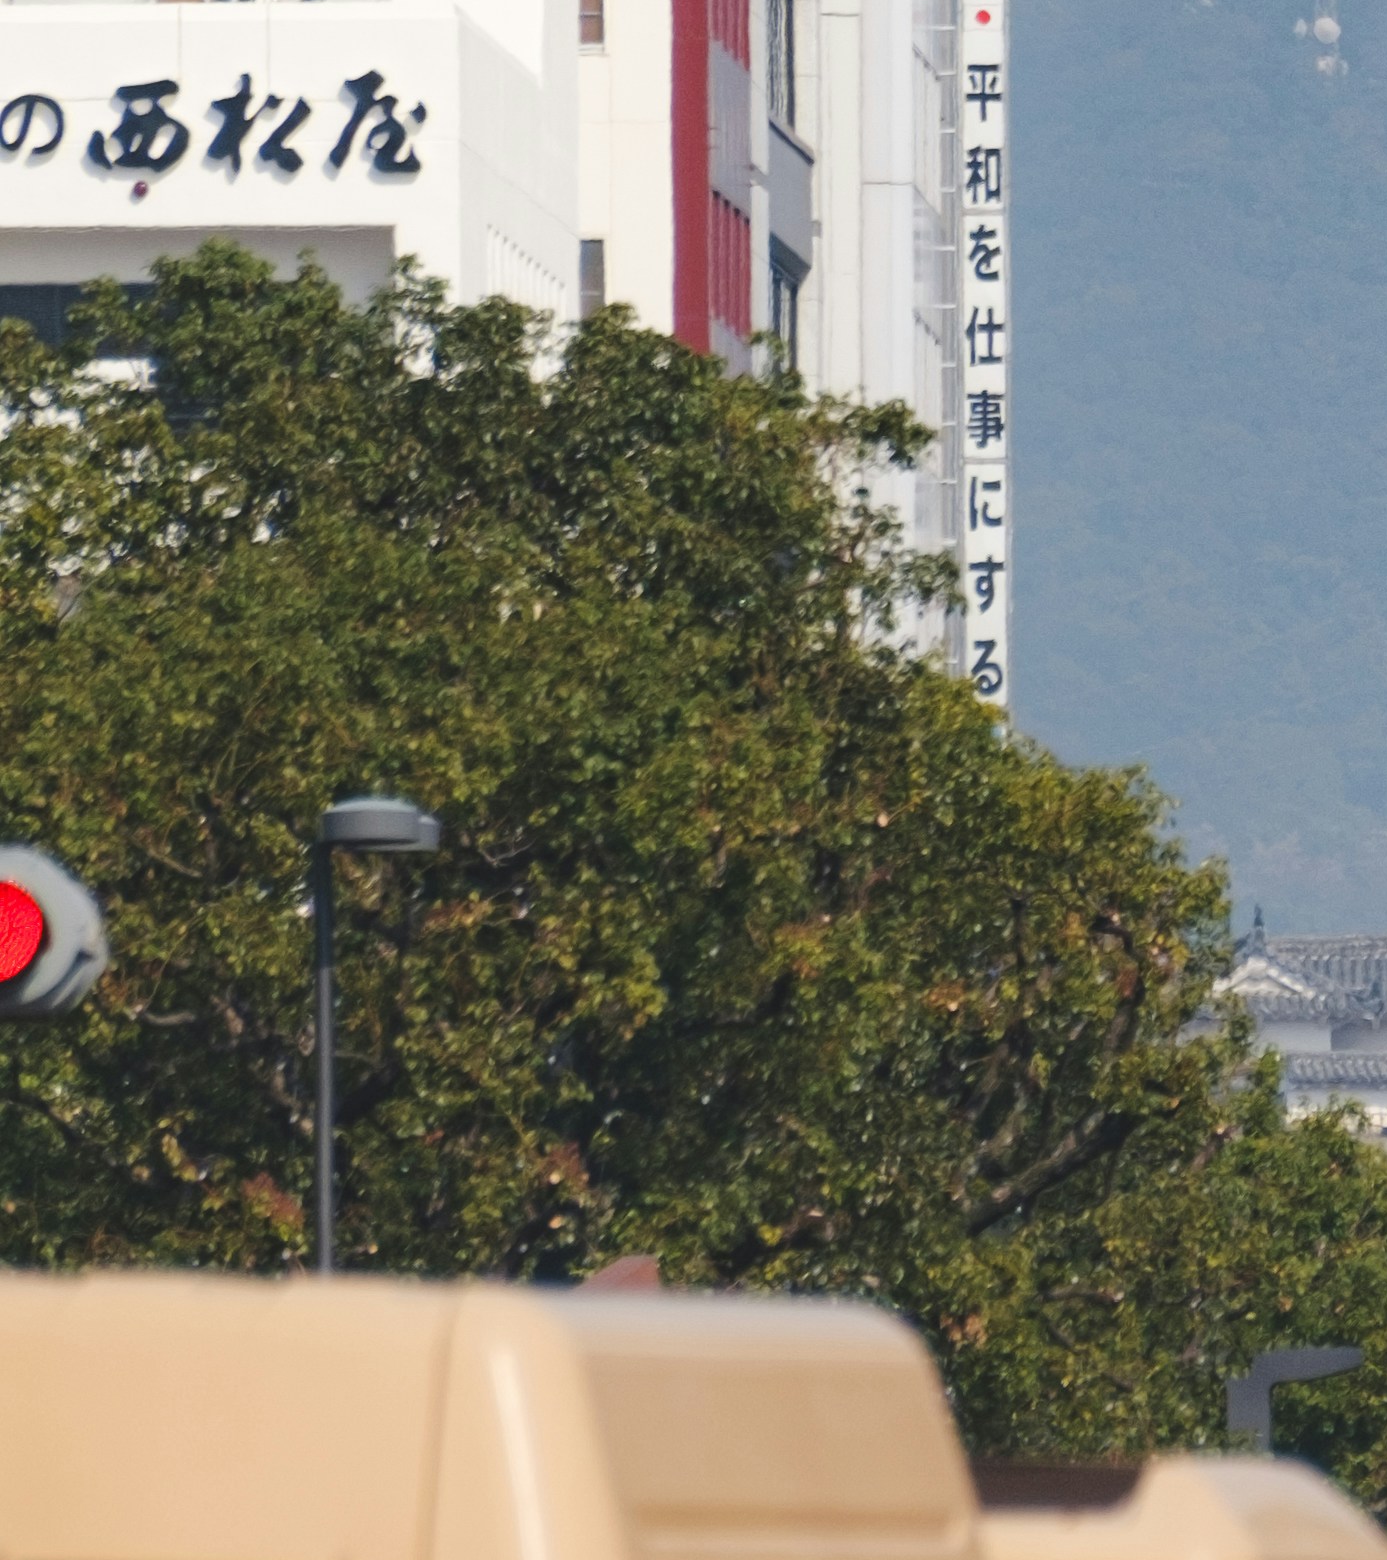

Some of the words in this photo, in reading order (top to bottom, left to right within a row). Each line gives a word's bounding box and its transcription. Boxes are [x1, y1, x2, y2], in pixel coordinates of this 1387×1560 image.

[0, 70, 428, 173] の西松屋
[966, 63, 1005, 695] 平和を仕事にする
